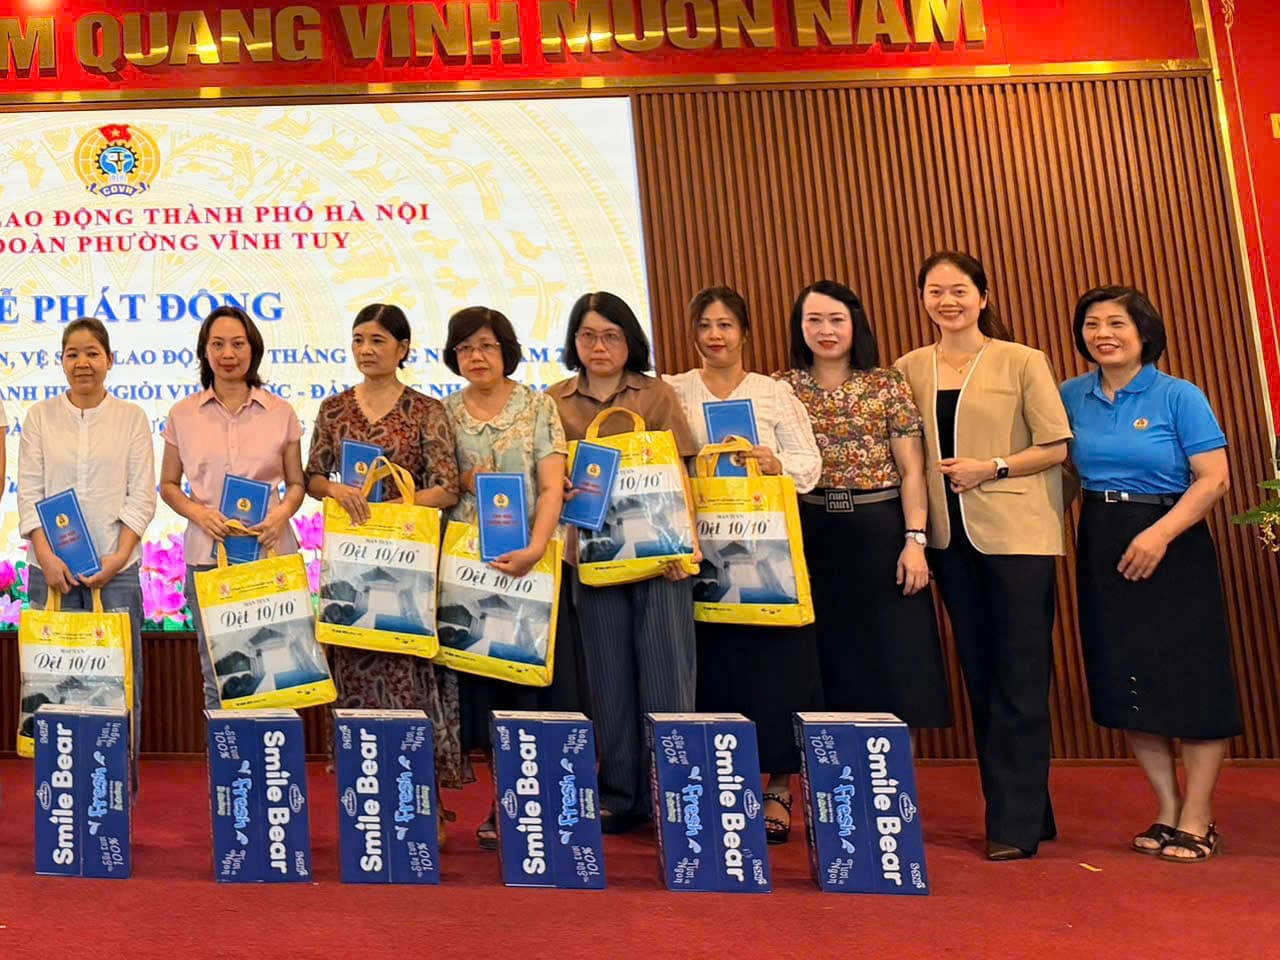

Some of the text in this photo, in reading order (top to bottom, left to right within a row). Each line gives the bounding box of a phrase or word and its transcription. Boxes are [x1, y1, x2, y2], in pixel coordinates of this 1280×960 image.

[75, 5, 321, 74] QUANG
[53, 207, 133, 230] ĐỘNG
[144, 203, 244, 224] THÀNH
[255, 200, 314, 223] PHỐ
[324, 200, 365, 222] HÀ
[376, 201, 431, 224] NỘI
[77, 231, 199, 253] PHƯỜNG
[208, 230, 281, 250] VĨNH
[292, 231, 350, 249] TUY
[32, 286, 146, 323] PHÁT
[267, 345, 346, 364] THÁNG
[620, 474, 660, 492] 10/10
[729, 520, 767, 537] 10/10
[375, 548, 415, 564] 10/10
[257, 601, 294, 622] 10/10
[69, 655, 107, 672] 10/10
[49, 722, 74, 865] Smile Bear
[264, 730, 290, 873] Smile Bear
[355, 728, 382, 872] Smile Bear
[516, 729, 545, 874] Smile Bear
[714, 734, 745, 882] Smile Bear
[867, 737, 902, 885] Smile Bear
